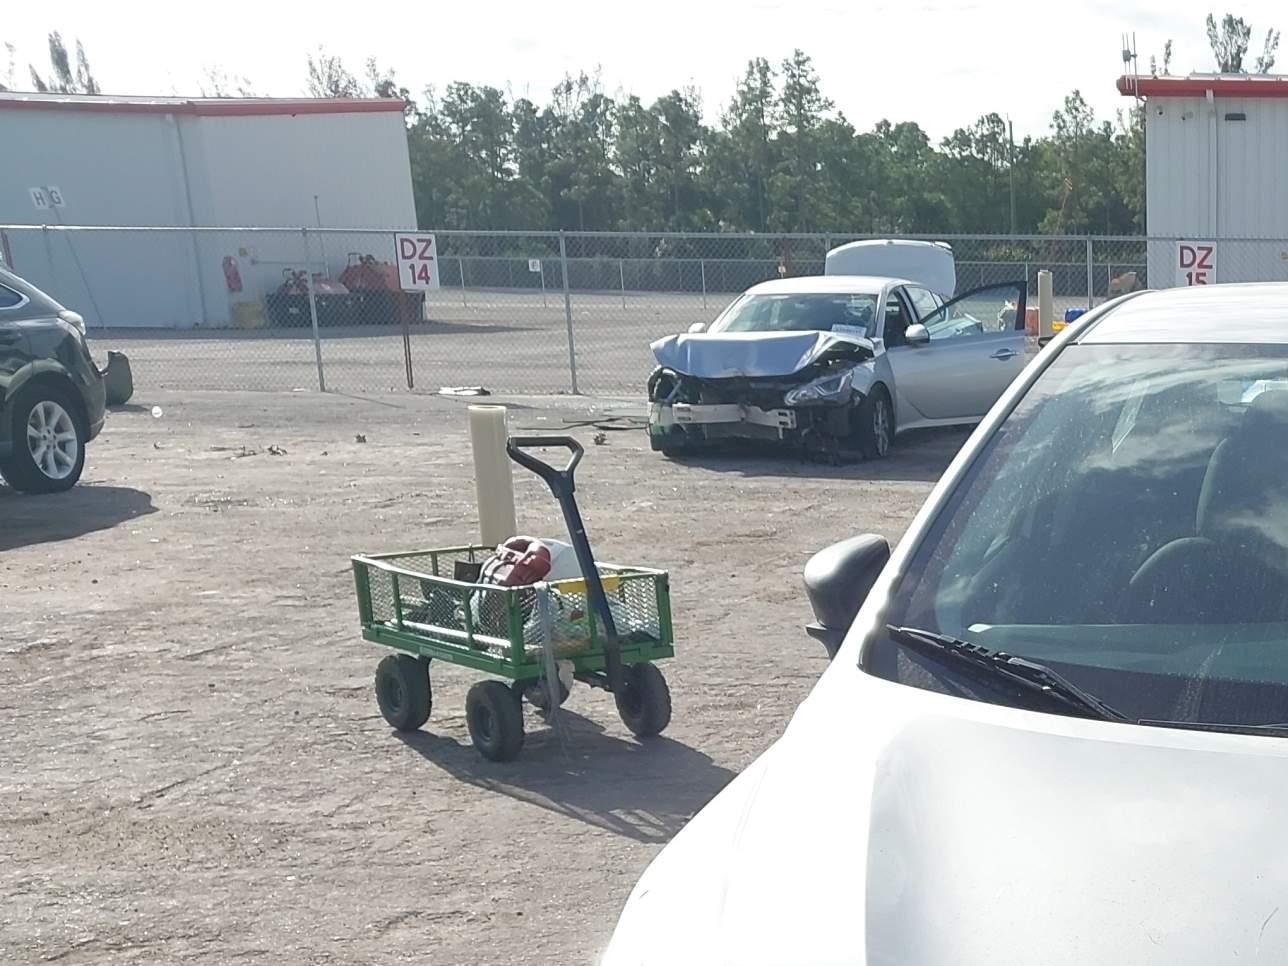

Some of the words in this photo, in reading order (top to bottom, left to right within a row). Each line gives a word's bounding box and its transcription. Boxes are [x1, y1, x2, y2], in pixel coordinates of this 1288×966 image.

[400, 238, 434, 261] DZ
[1180, 246, 1213, 269] DZ
[408, 263, 431, 285] 14
